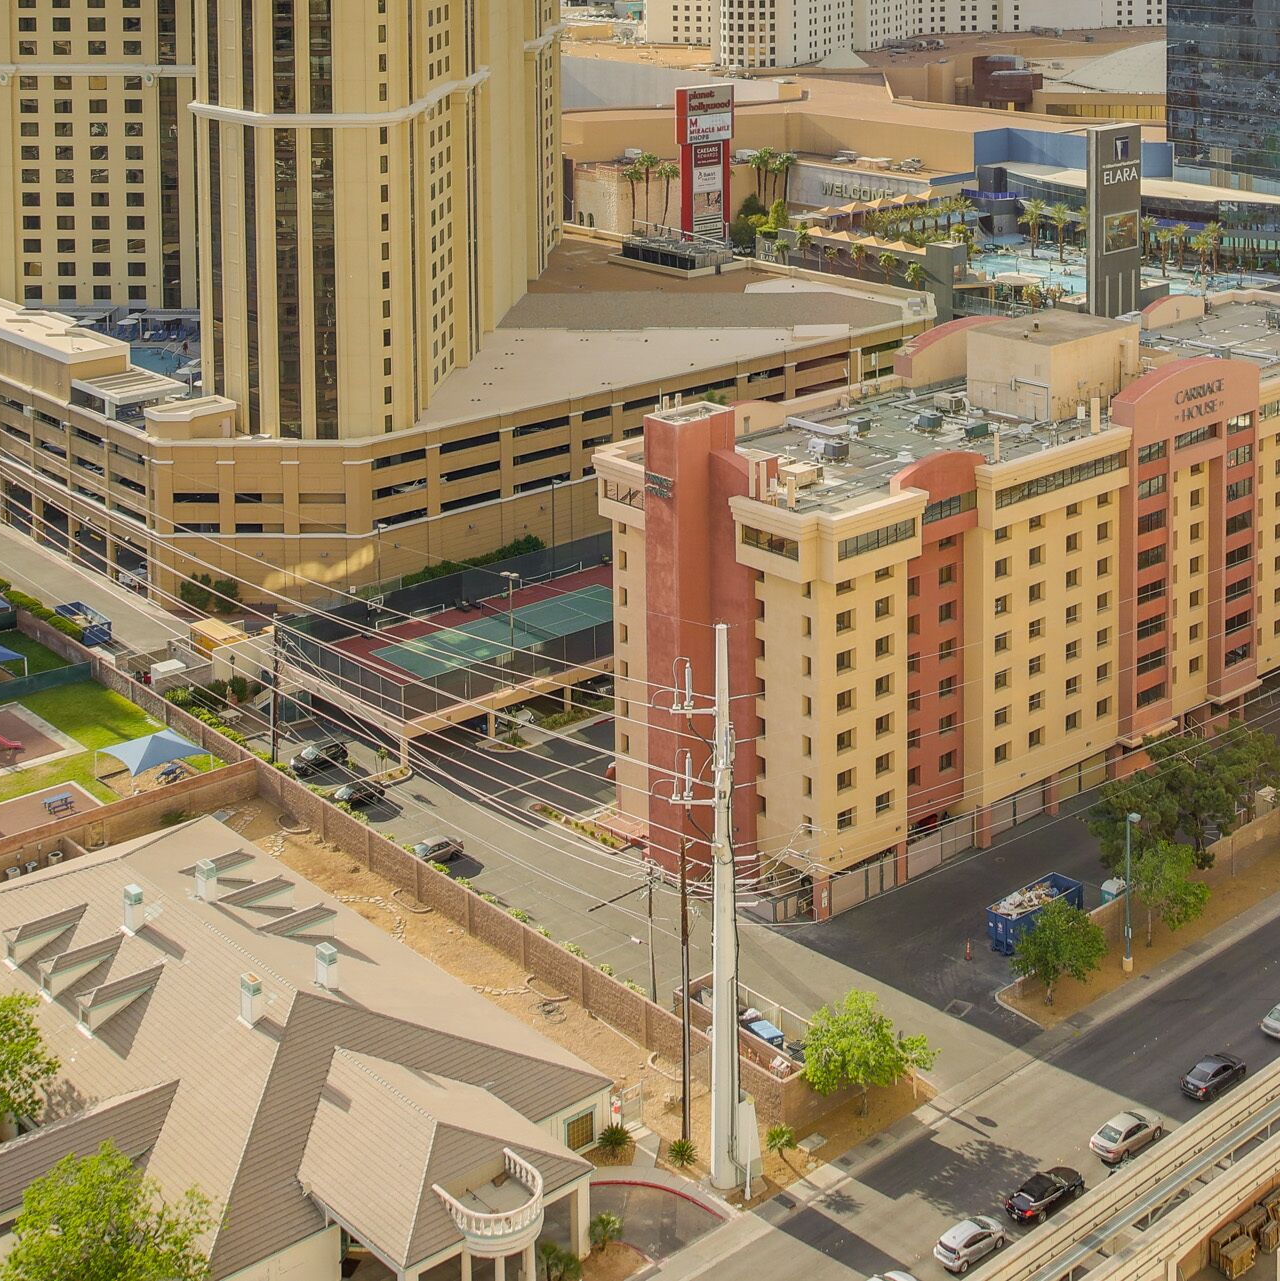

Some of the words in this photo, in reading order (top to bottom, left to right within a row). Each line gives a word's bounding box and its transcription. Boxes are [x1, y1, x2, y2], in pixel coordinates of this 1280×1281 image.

[688, 90, 715, 102] planet
[688, 99, 730, 113] hollywood
[689, 126, 715, 135] MIRACLE
[717, 124, 730, 132] MILE
[1103, 166, 1139, 186] ELARA
[822, 181, 895, 201] WELCOME
[1175, 377, 1225, 405] CARRIAGE
[1181, 398, 1218, 422] HOUSE
